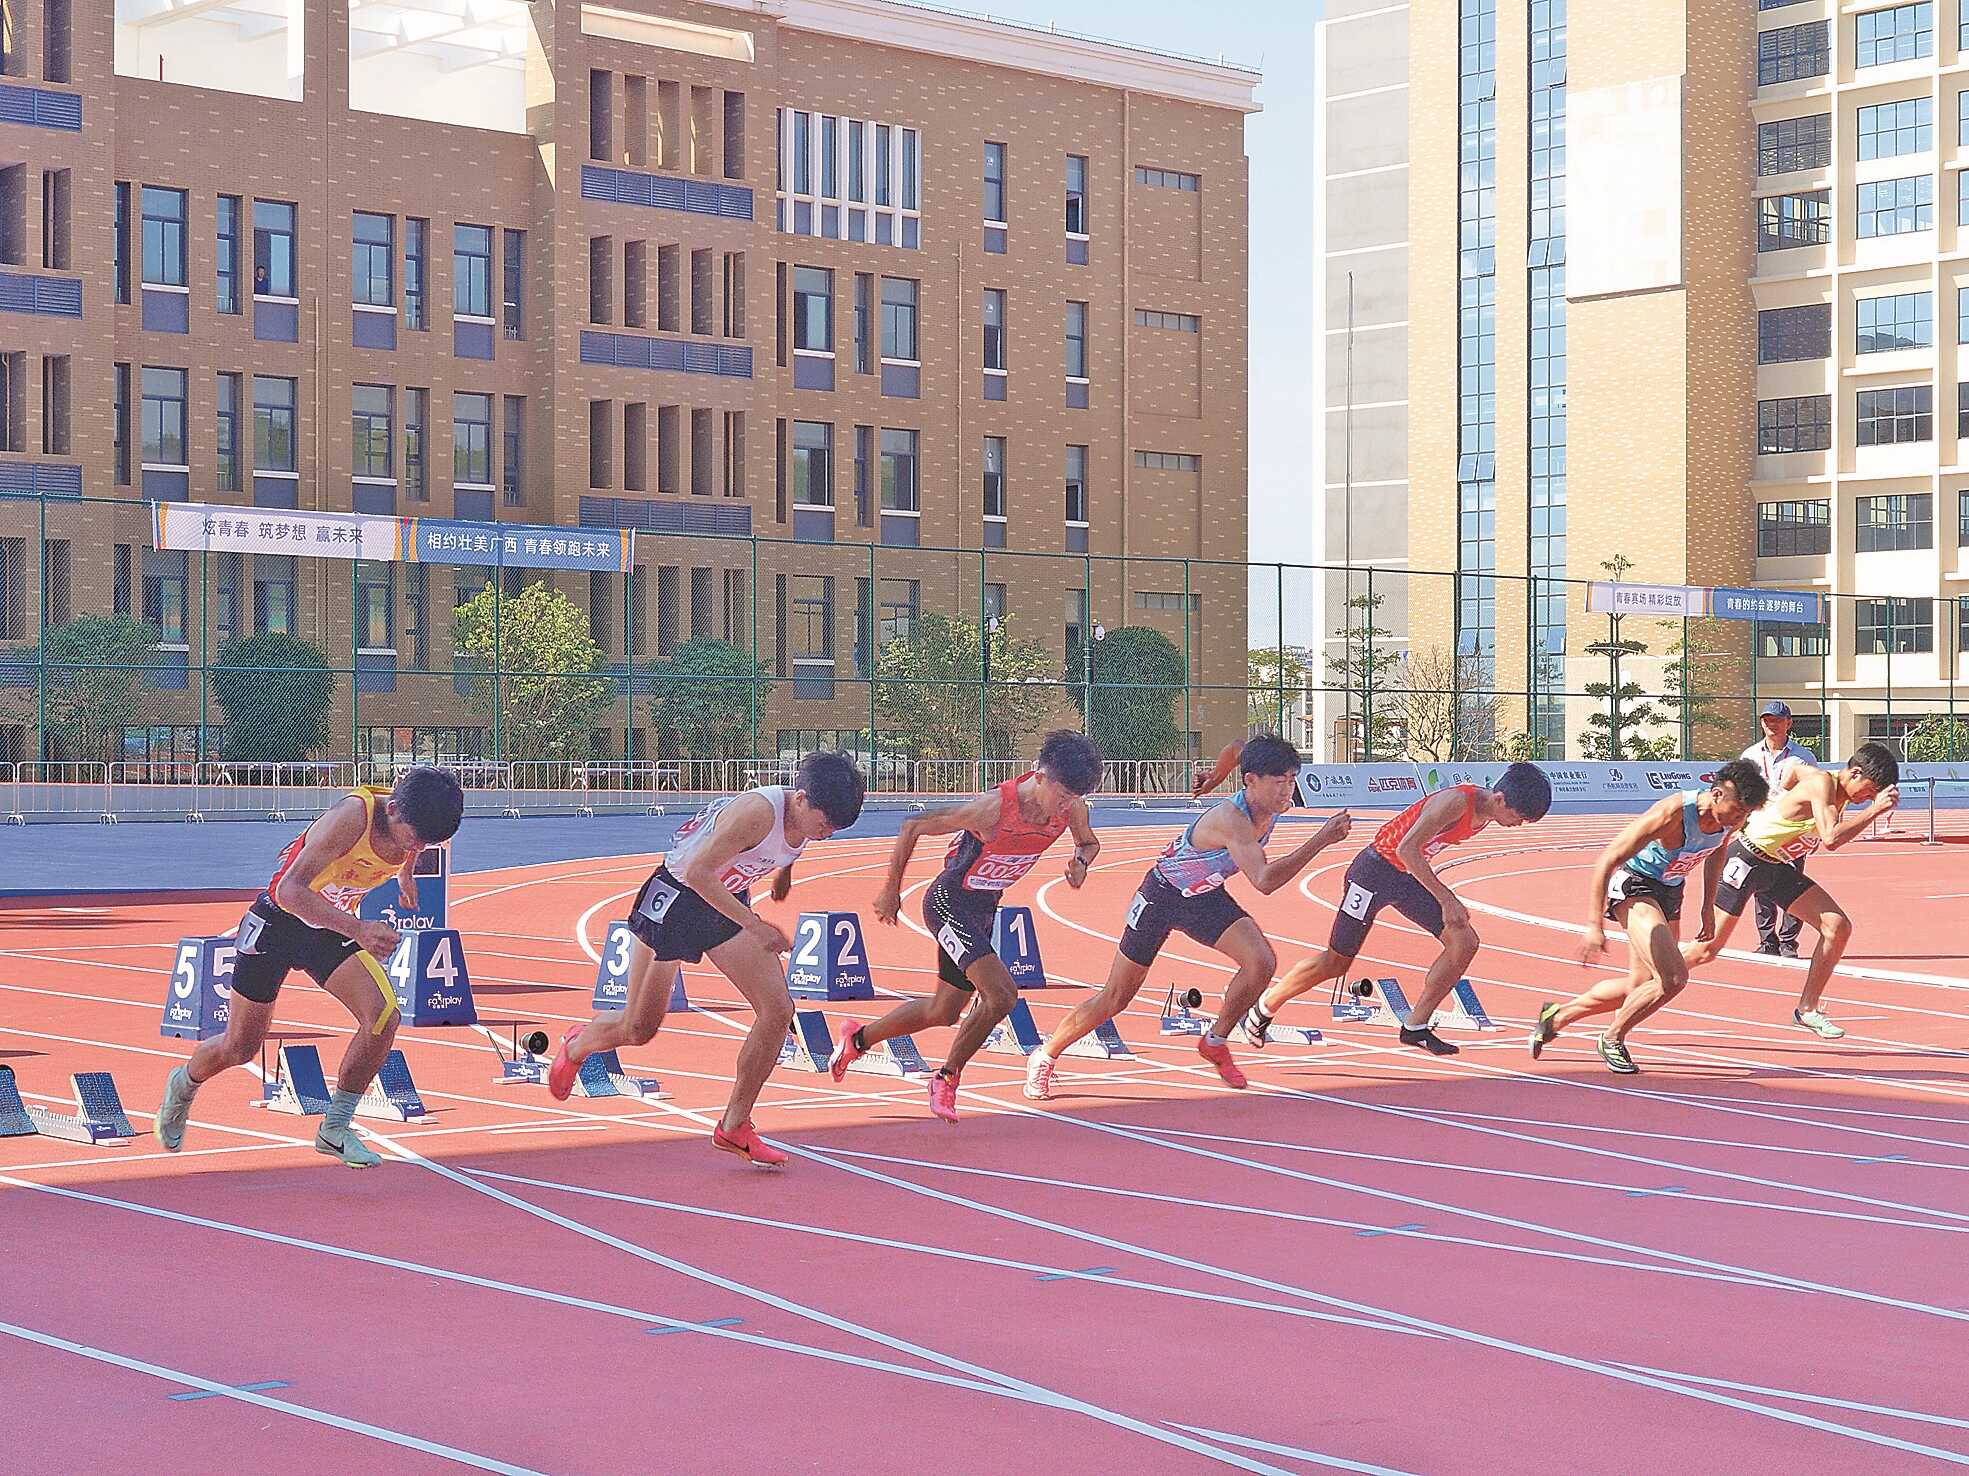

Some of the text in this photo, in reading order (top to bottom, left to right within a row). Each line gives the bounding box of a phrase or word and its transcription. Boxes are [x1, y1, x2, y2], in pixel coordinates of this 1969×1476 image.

[202, 518, 364, 544] 炫青春 筑梦想 赢未来
[427, 532, 611, 559] 相约壮美广西 青春领跑未来
[1729, 866, 1740, 880] 1
[651, 892, 669, 912] 6
[1132, 903, 1141, 920] 4
[1350, 893, 1363, 911] 3
[247, 922, 257, 945] 7
[795, 919, 822, 966] 2
[834, 920, 859, 966] 2
[944, 934, 956, 951] 5
[1009, 913, 1028, 957] 1
[390, 937, 412, 988] 4
[426, 937, 458, 987] 4
[607, 927, 631, 977] 3
[174, 945, 198, 999] 5
